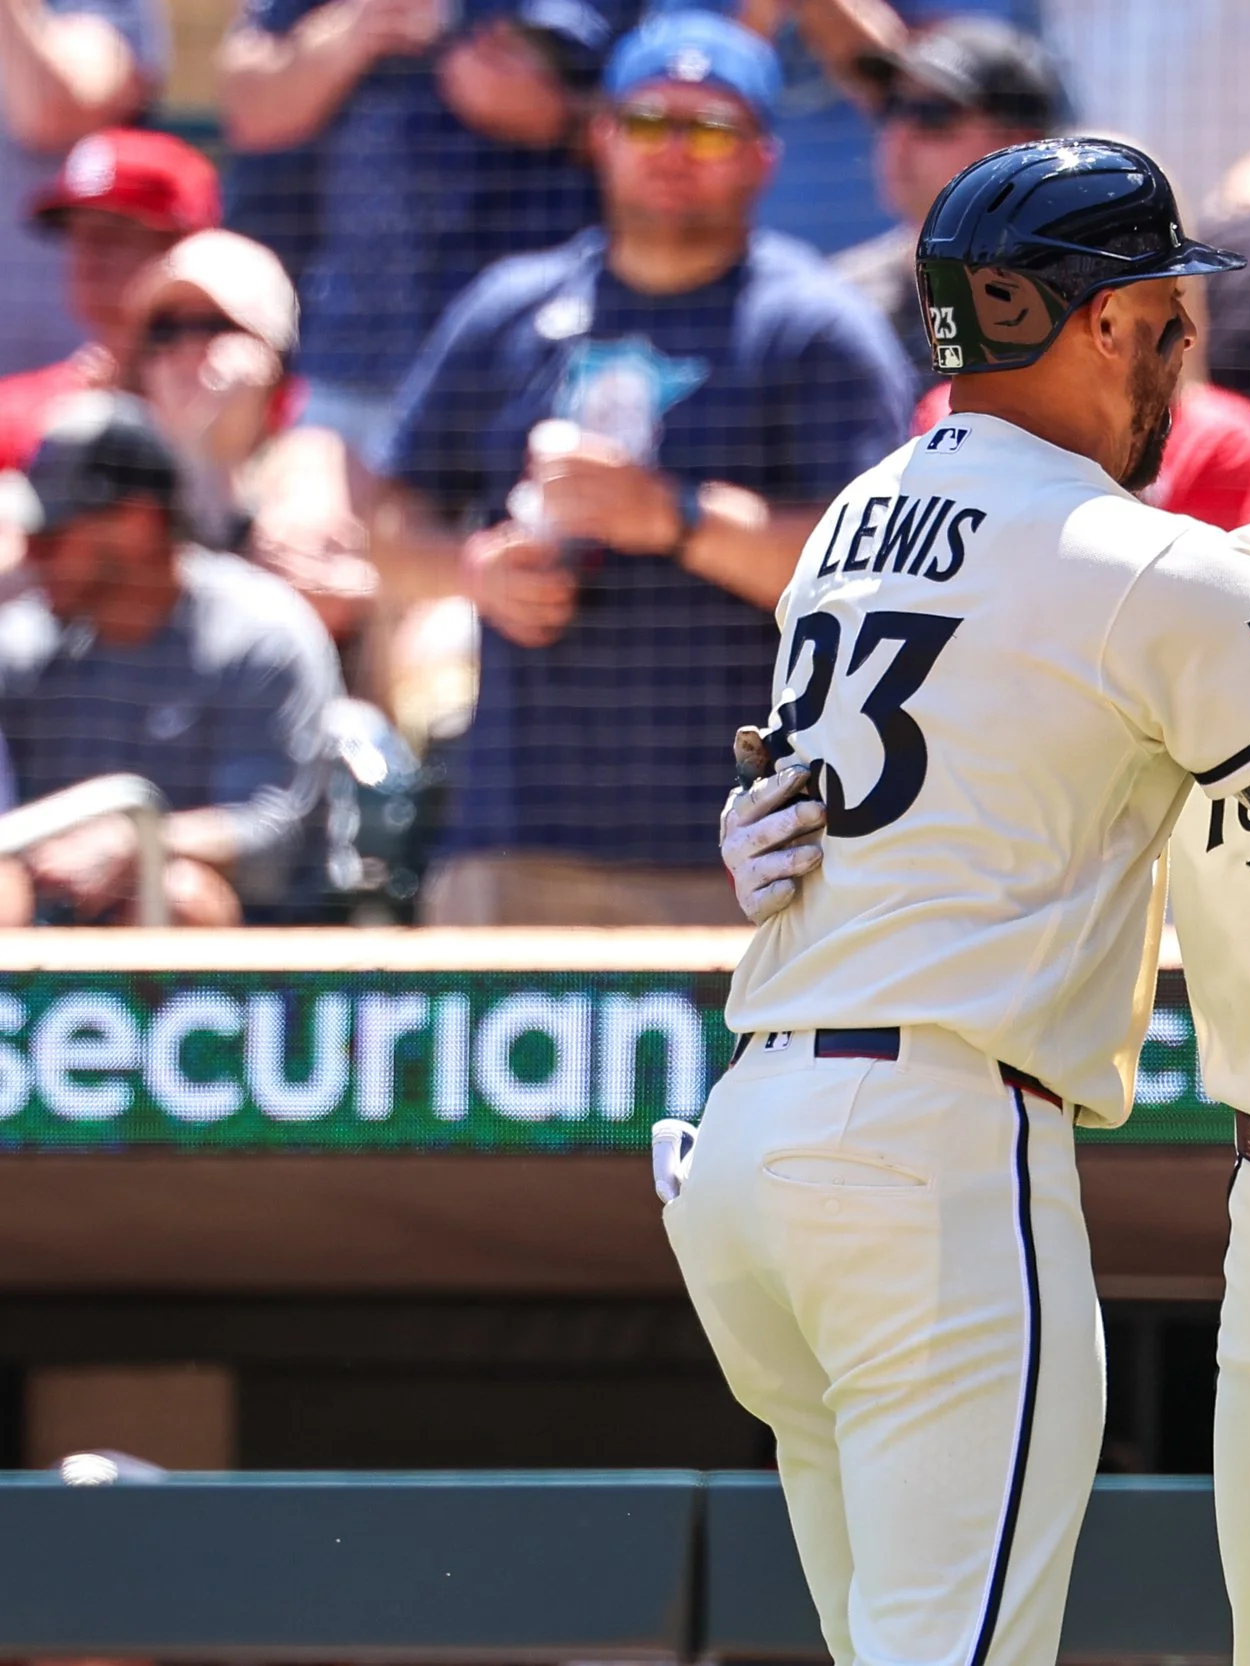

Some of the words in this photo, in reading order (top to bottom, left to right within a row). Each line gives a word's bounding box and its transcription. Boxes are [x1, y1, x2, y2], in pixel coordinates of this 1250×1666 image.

[930, 307, 957, 339] 23
[817, 496, 986, 582] LEWIS
[764, 611, 964, 838] 23
